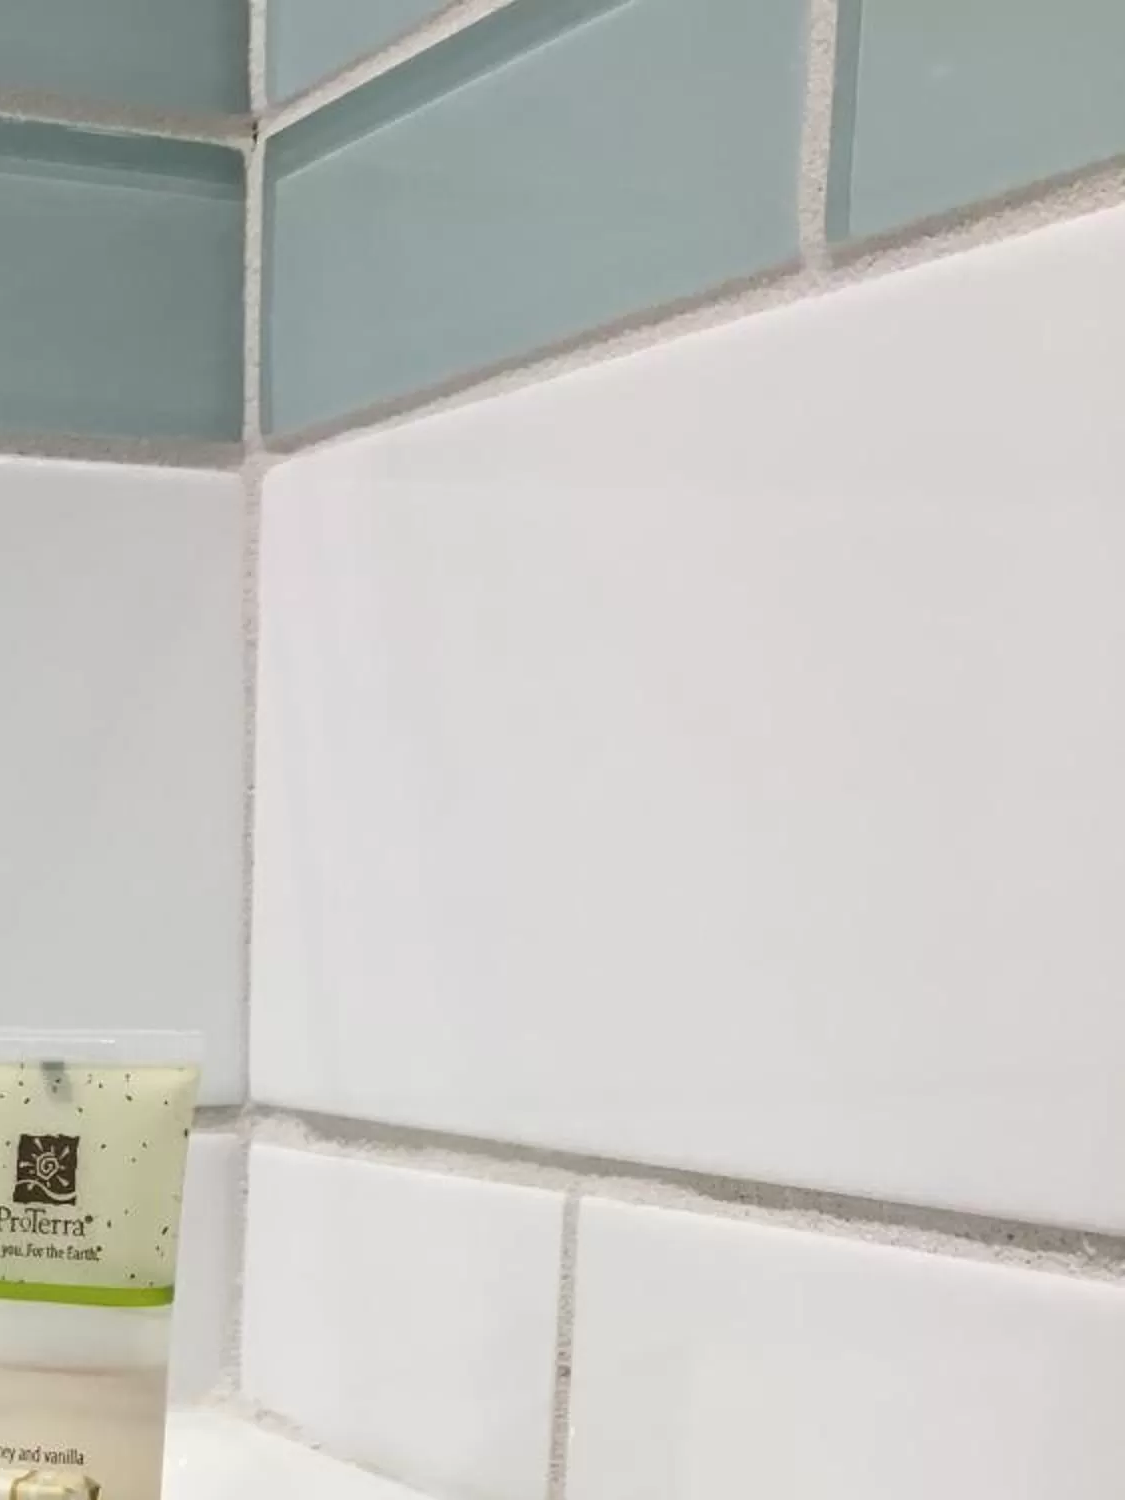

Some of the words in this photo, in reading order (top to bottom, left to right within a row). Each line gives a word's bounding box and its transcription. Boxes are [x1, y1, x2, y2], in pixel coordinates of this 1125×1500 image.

[26, 1243, 44, 1258] For
[46, 1242, 64, 1260] the
[18, 1445, 41, 1463] and
[43, 1448, 84, 1466] vanilla
